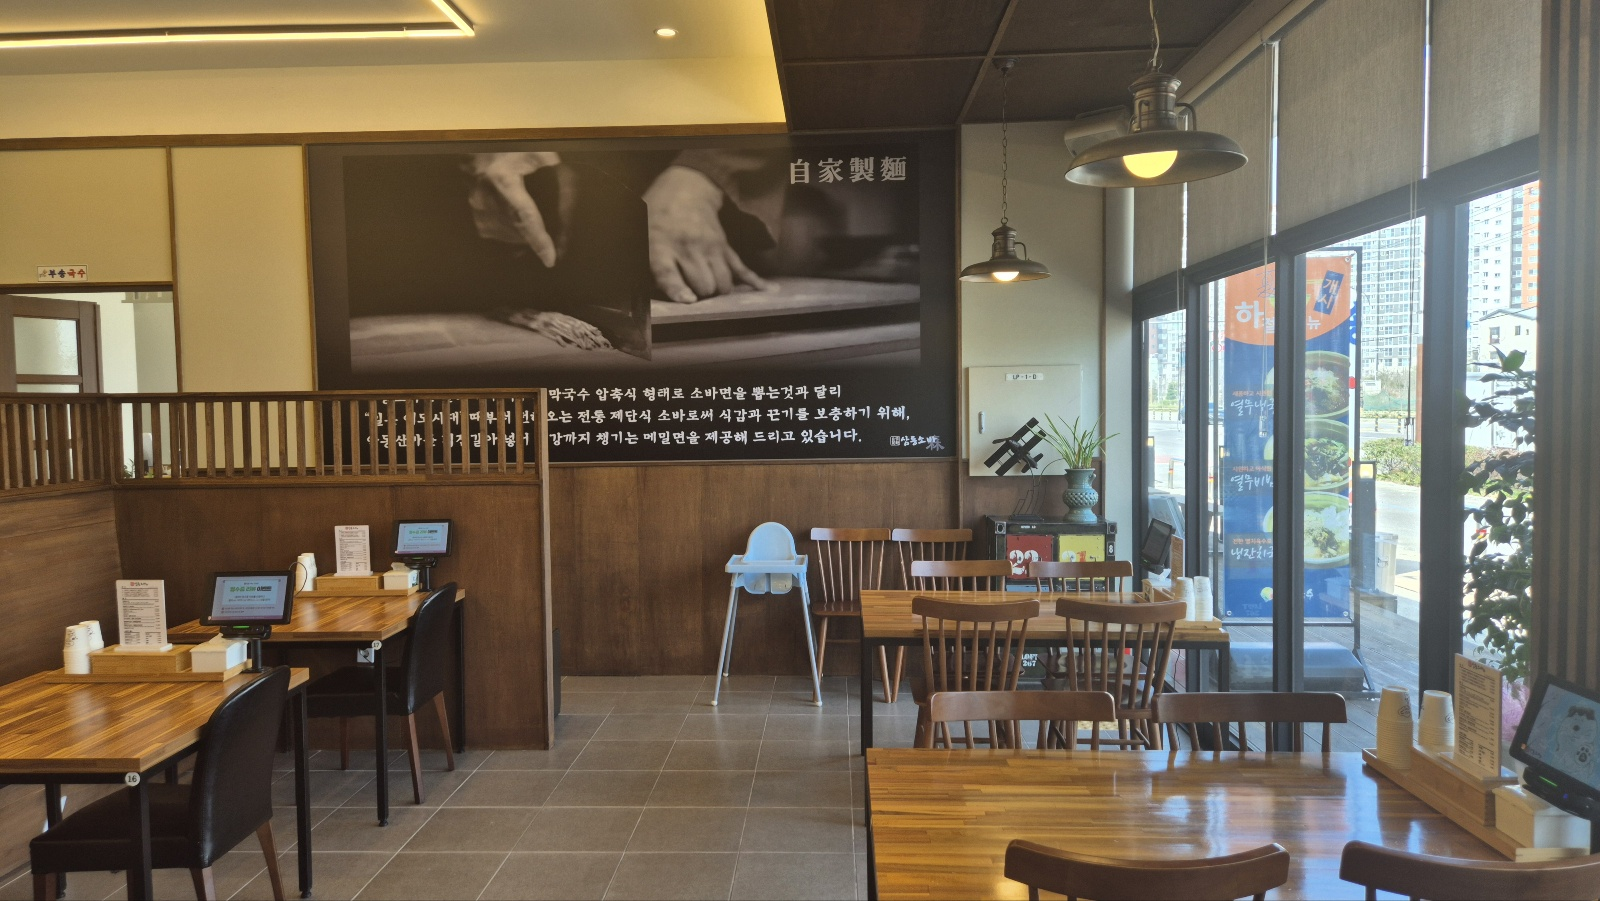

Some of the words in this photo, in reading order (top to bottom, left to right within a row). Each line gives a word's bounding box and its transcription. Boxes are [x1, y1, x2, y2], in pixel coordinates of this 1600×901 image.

[790, 156, 907, 184] 自家製麵
[48, 269, 86, 279] 부송국수
[1319, 278, 1340, 310] 개시
[549, 387, 590, 402] 막국수
[596, 387, 637, 402] 압축식
[643, 386, 685, 402] 형태로
[690, 386, 747, 401] 소바면을
[752, 385, 809, 401] 뽑는것과
[814, 384, 841, 400] 달리
[577, 409, 606, 424] 전통
[610, 409, 652, 424] 제단식
[658, 409, 714, 423] 소바로써
[719, 408, 763, 423] 식감과
[767, 407, 810, 422] 끈기를
[814, 406, 871, 422] 보충하기
[877, 405, 910, 421] 위해,
[596, 431, 639, 446] 챙기는
[643, 430, 701, 445] 메밀면을
[705, 430, 748, 446] 제공해
[752, 429, 796, 444] 드리고
[800, 428, 862, 444] 있습니다.
[127, 775, 138, 783] 16
